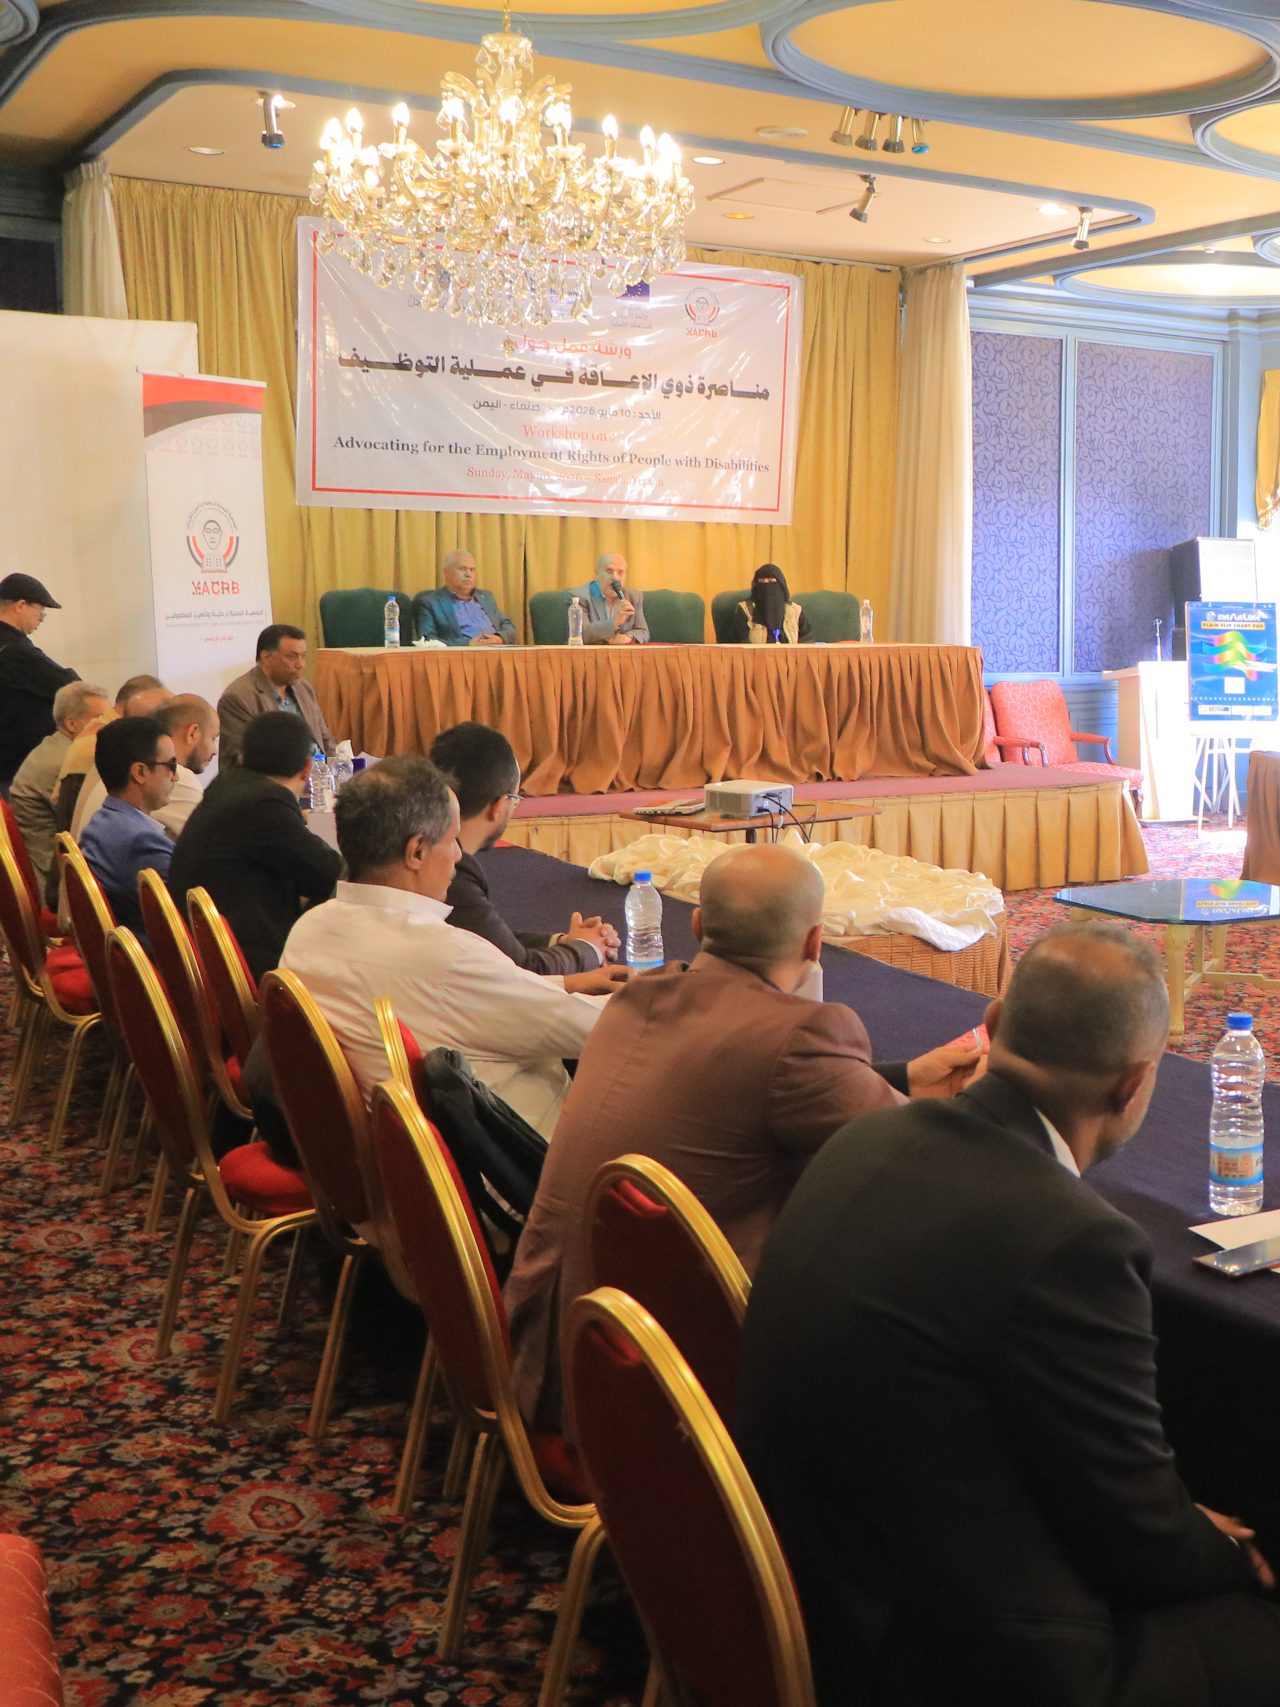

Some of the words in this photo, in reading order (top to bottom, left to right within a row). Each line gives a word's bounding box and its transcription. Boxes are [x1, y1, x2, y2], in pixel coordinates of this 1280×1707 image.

[554, 338, 588, 354] عمل
[593, 337, 632, 359] ورشة
[338, 347, 445, 378] التوظيف
[450, 355, 526, 381] عملية
[531, 362, 574, 392] في
[578, 363, 658, 395] الإعاقة
[660, 375, 694, 399] ذوي
[523, 425, 589, 442] Workshop
[591, 433, 608, 442] on
[334, 436, 419, 455] Advocating
[423, 441, 445, 454] for
[448, 442, 471, 455] the
[476, 444, 564, 461] Employment
[567, 450, 609, 465] Rights
[612, 452, 628, 464] of
[629, 453, 672, 468] People
[675, 455, 700, 468] with
[705, 457, 770, 473] Disabilities
[467, 467, 508, 480] Sunday,
[514, 468, 535, 481] May
[191, 580, 241, 596] YACRB
